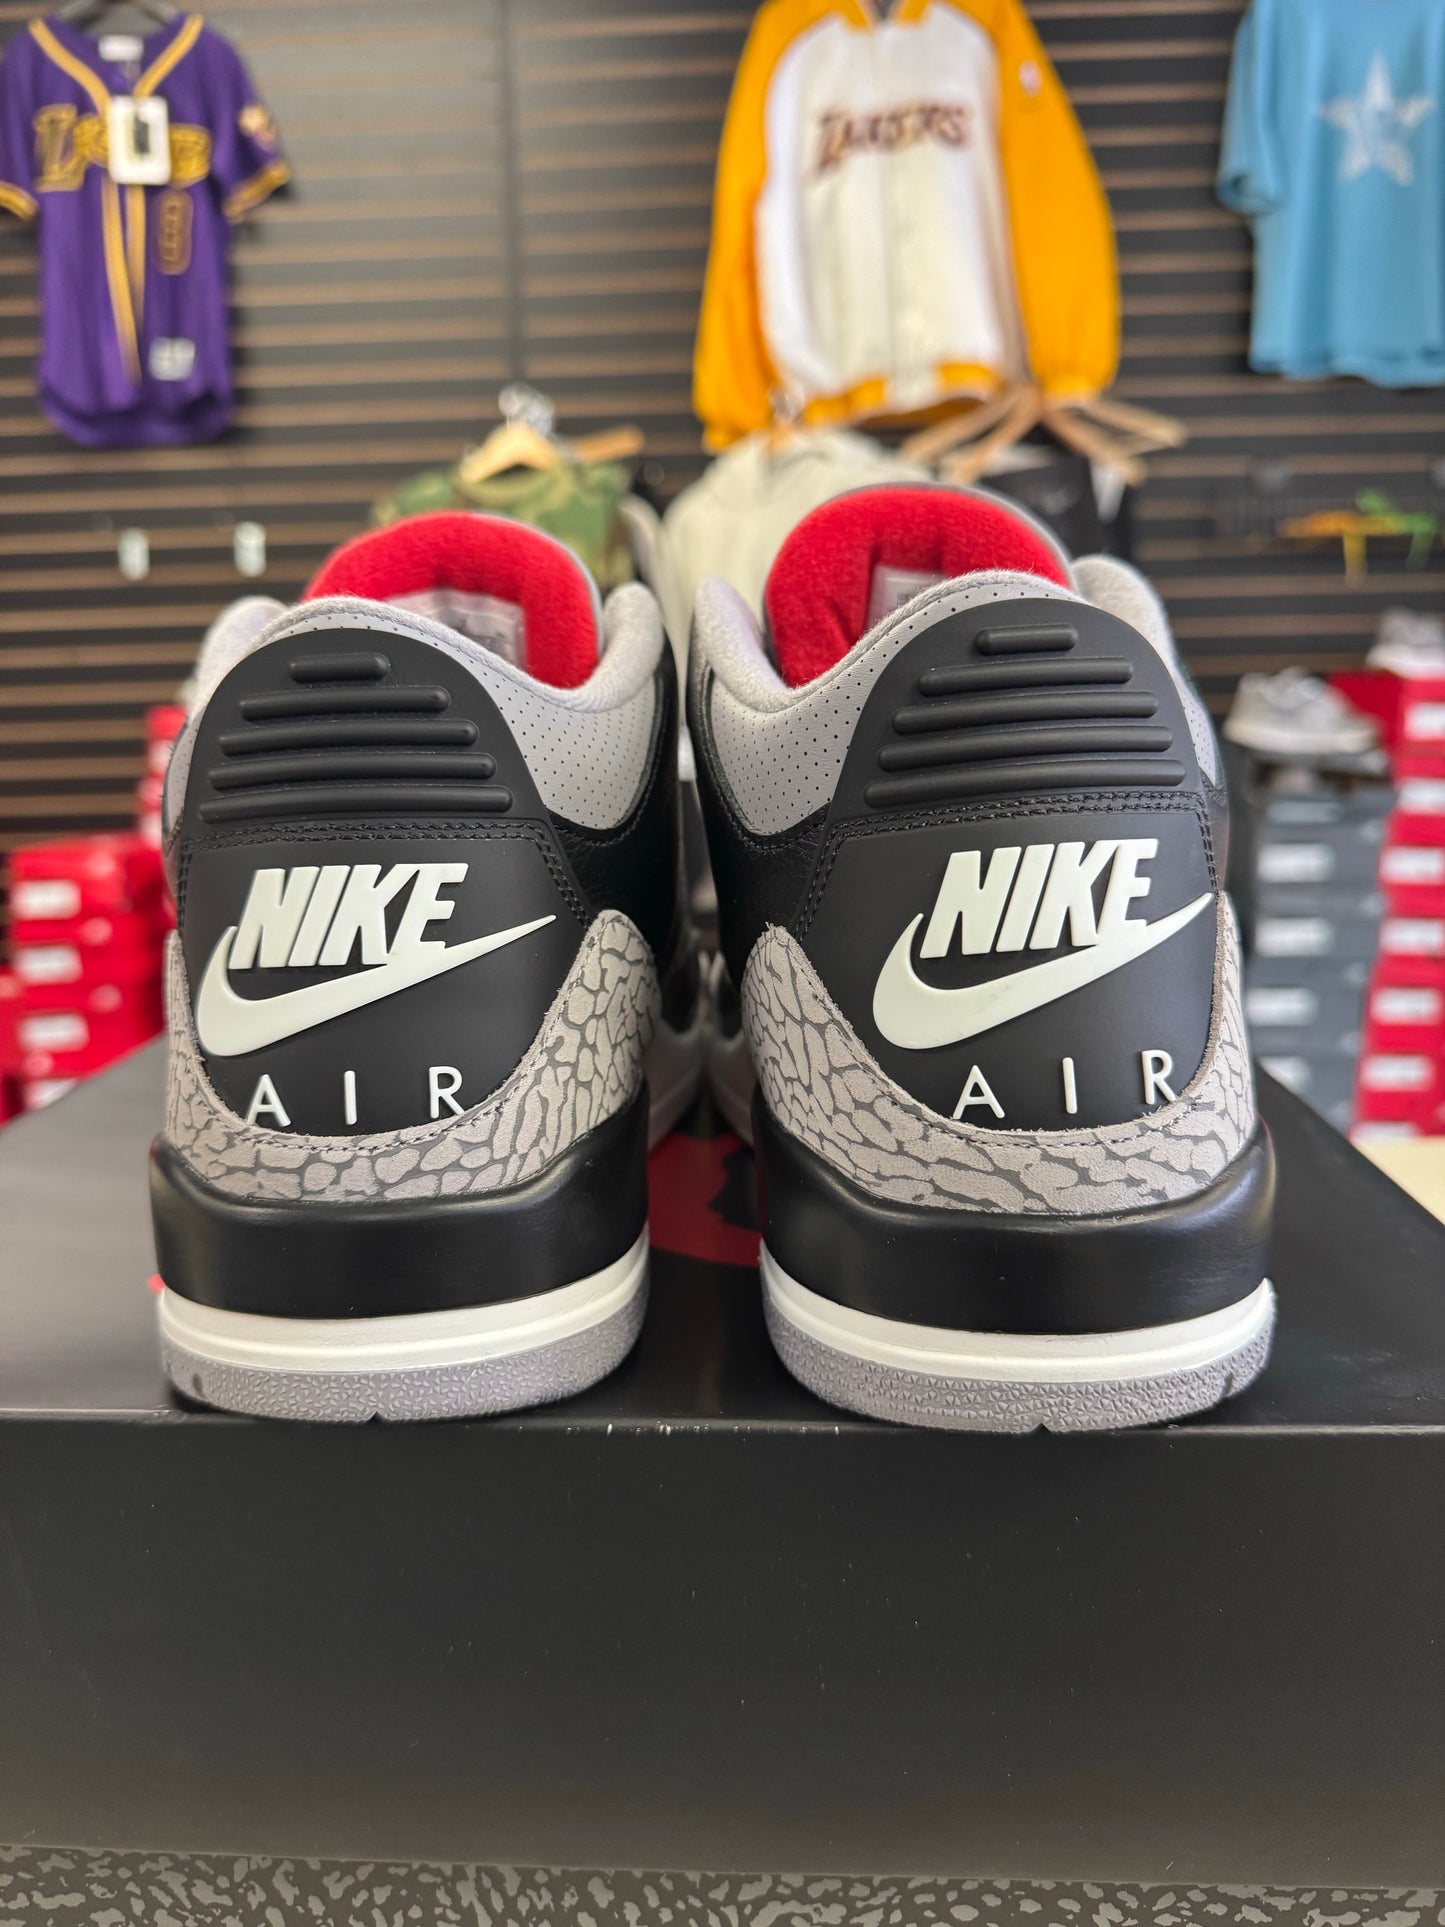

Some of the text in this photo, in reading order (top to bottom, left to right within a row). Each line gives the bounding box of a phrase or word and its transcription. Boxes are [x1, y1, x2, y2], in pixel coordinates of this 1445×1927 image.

[229, 863, 468, 970] NIKE
[919, 838, 1158, 959] NIKE
[246, 1066, 465, 1127] AIR
[952, 1049, 1177, 1120] AIR
